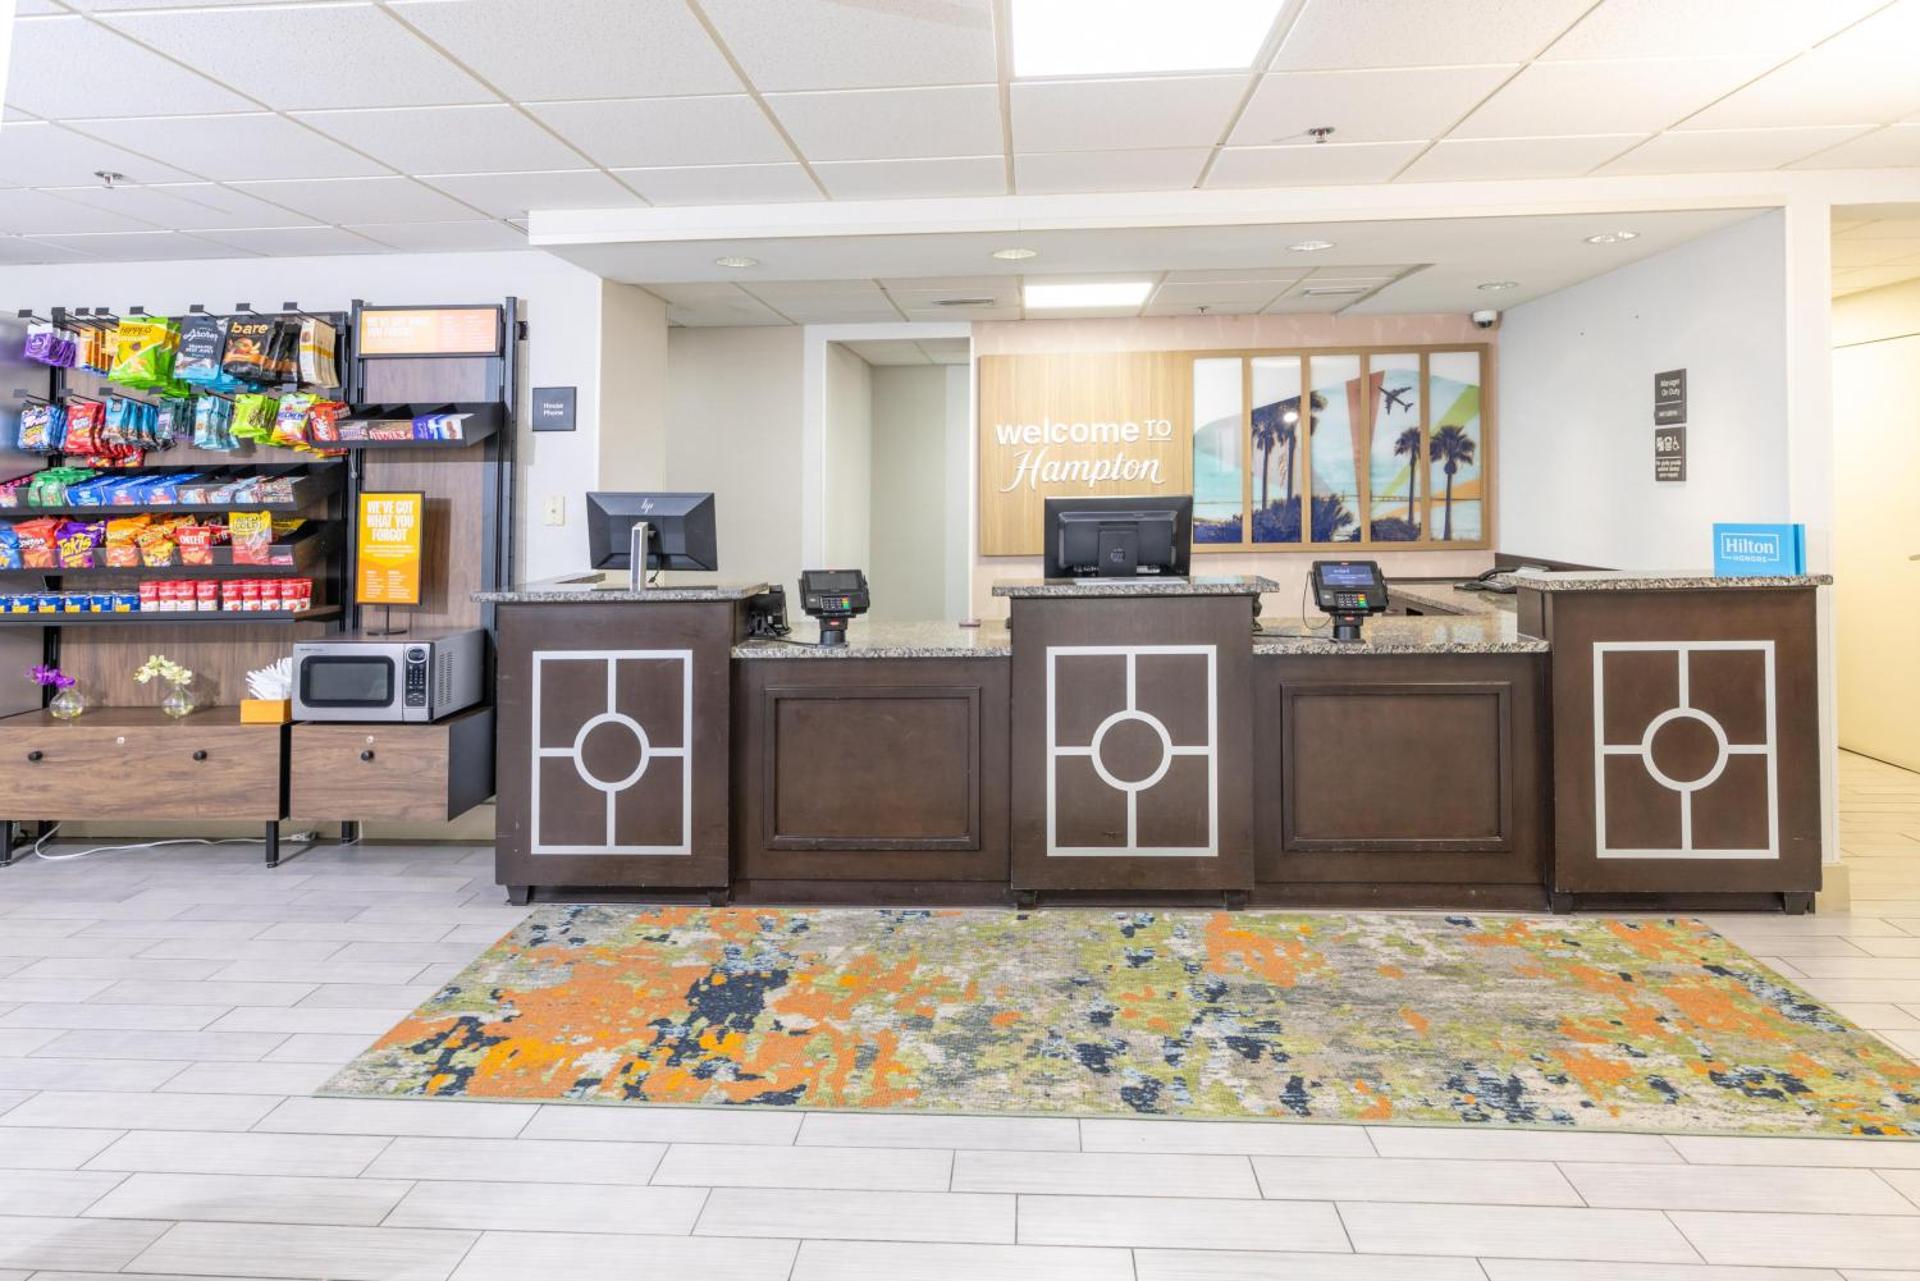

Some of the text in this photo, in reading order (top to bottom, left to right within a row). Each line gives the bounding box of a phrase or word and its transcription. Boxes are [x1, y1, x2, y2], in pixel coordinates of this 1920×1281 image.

[231, 322, 269, 335] bare
[543, 410, 564, 418] Phone
[995, 416, 1173, 445] welcome TO
[1000, 446, 1167, 494] Hampton
[366, 500, 414, 514] WE'VE GOT
[641, 498, 654, 515] hp
[366, 514, 414, 528] WHAT YOU
[372, 528, 408, 542] FORGOT
[57, 533, 92, 556] Takis
[1725, 537, 1775, 555] Hilton
